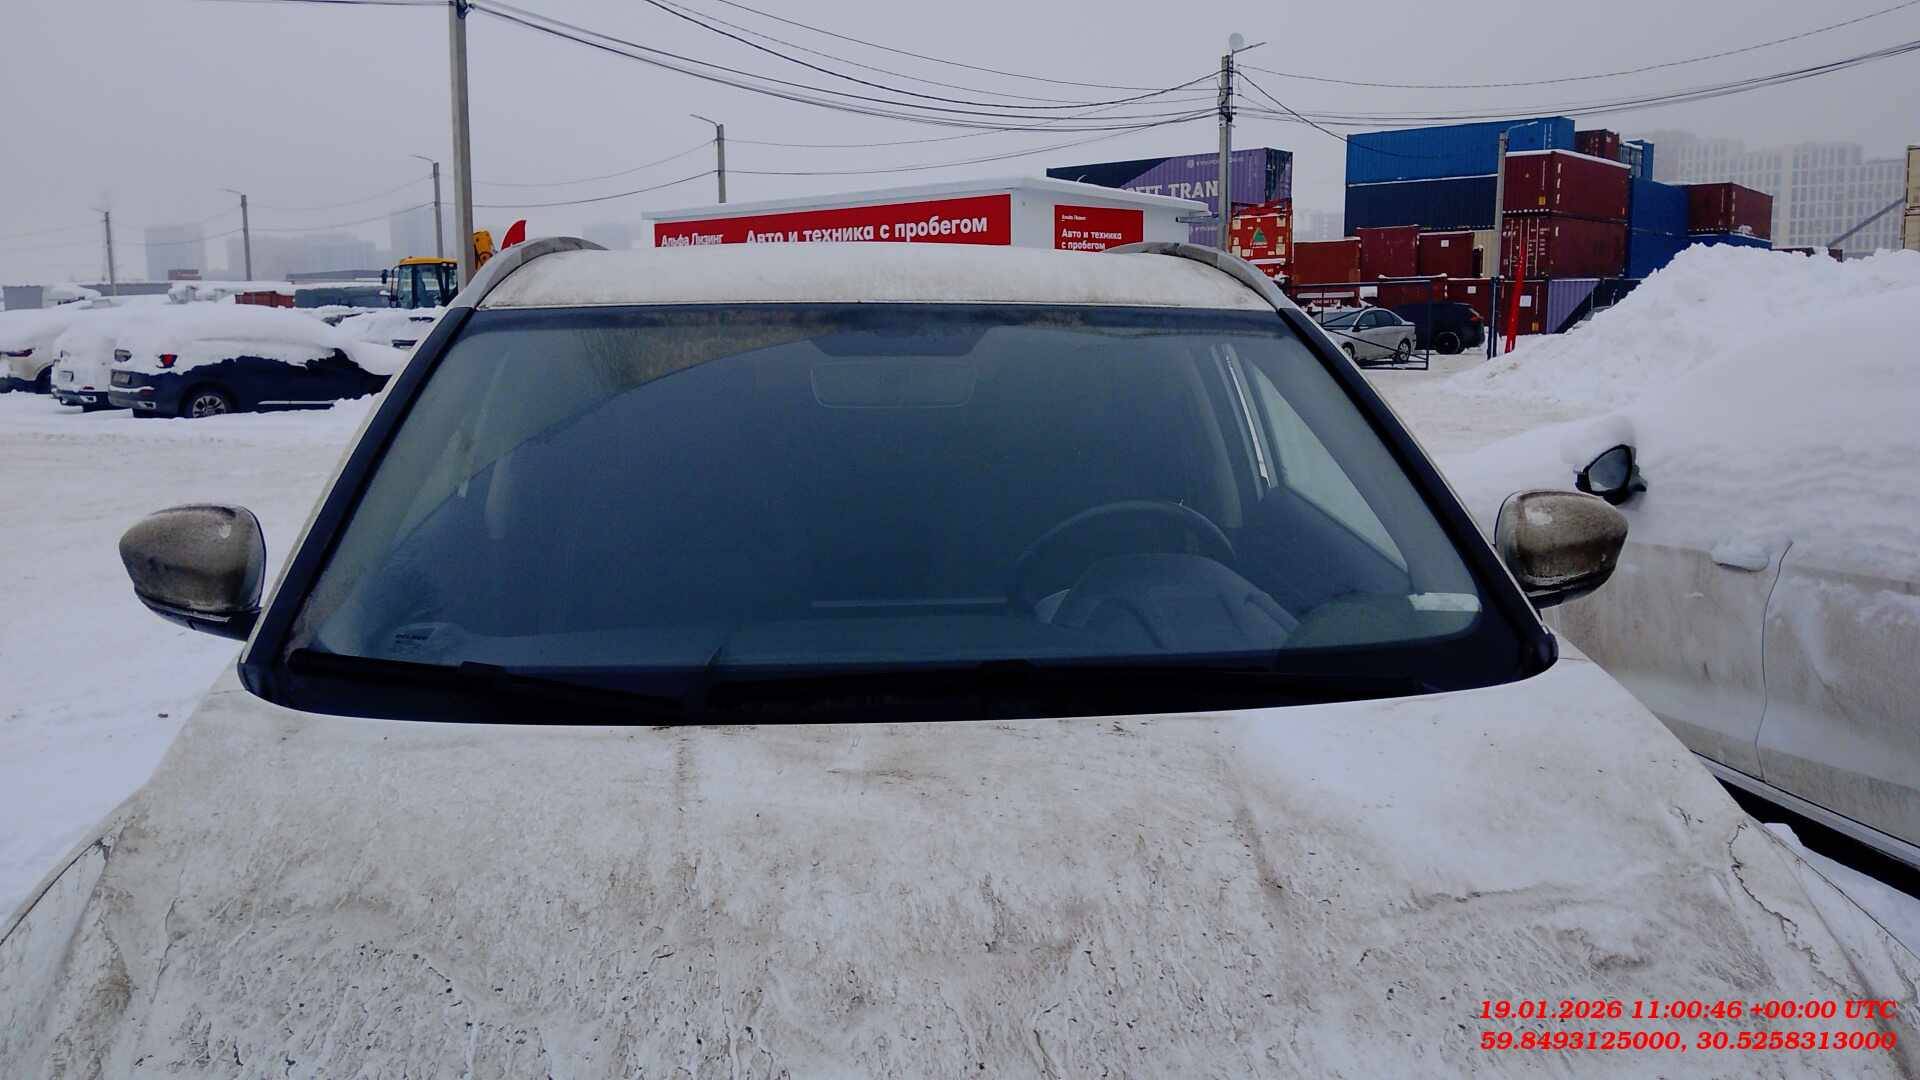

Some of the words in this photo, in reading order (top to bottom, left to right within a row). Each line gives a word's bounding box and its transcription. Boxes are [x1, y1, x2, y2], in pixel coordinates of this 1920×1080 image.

[1168, 180, 1219, 199] TRAN
[746, 229, 784, 244] Авто
[788, 231, 798, 243] и
[803, 225, 874, 243] техника
[880, 223, 890, 239] с
[895, 215, 988, 242] пробегом
[1061, 228, 1082, 238] Авто
[1091, 231, 1122, 240] техника
[1067, 240, 1105, 252] пробегом
